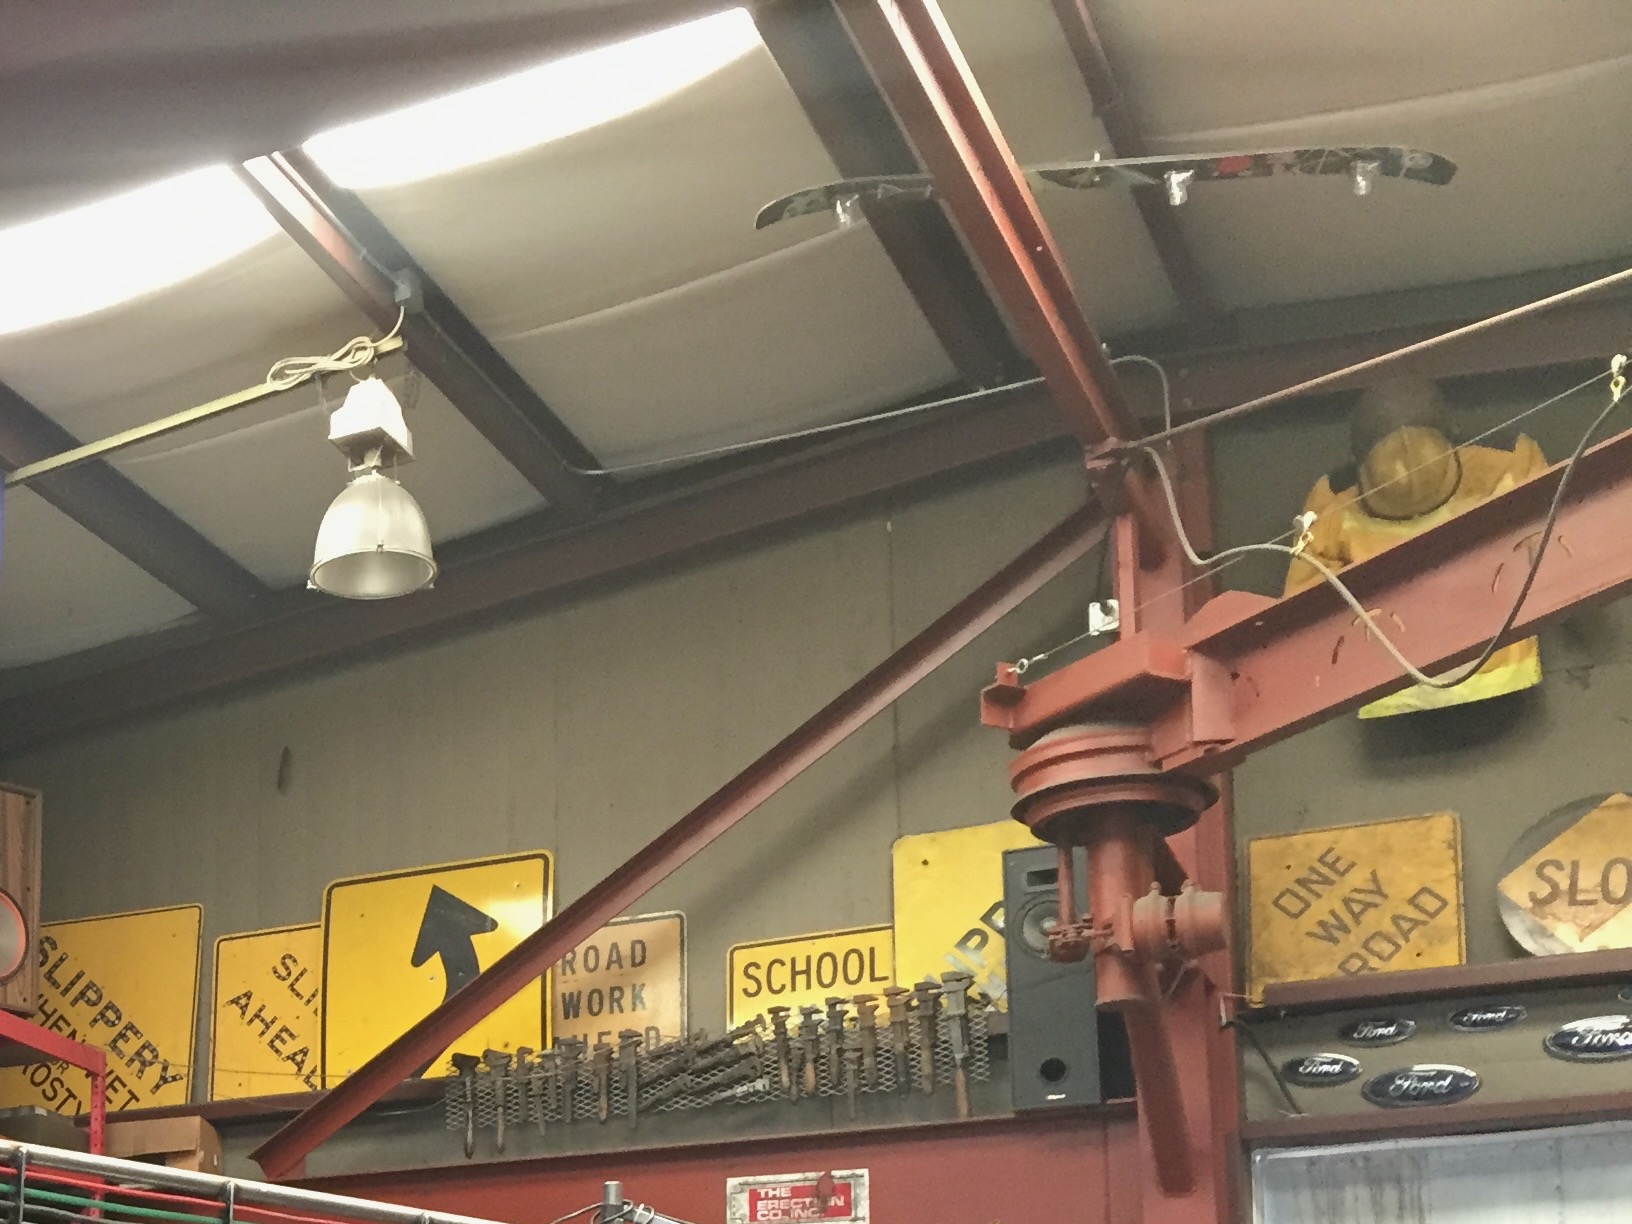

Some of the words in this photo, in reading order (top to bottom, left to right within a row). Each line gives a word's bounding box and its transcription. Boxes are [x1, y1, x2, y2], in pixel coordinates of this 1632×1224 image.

[1272, 847, 1357, 921] ONE
[1306, 869, 1389, 947] WAY
[561, 939, 647, 976] ROAD
[1337, 886, 1449, 976] ROAD
[271, 953, 318, 1017] SLI
[742, 947, 889, 998] SCHOOL
[39, 936, 184, 1095] SLIPPERY
[561, 983, 648, 1020] WORK
[1389, 1070, 1453, 1097] Ford
[757, 1187, 791, 1198] THE
